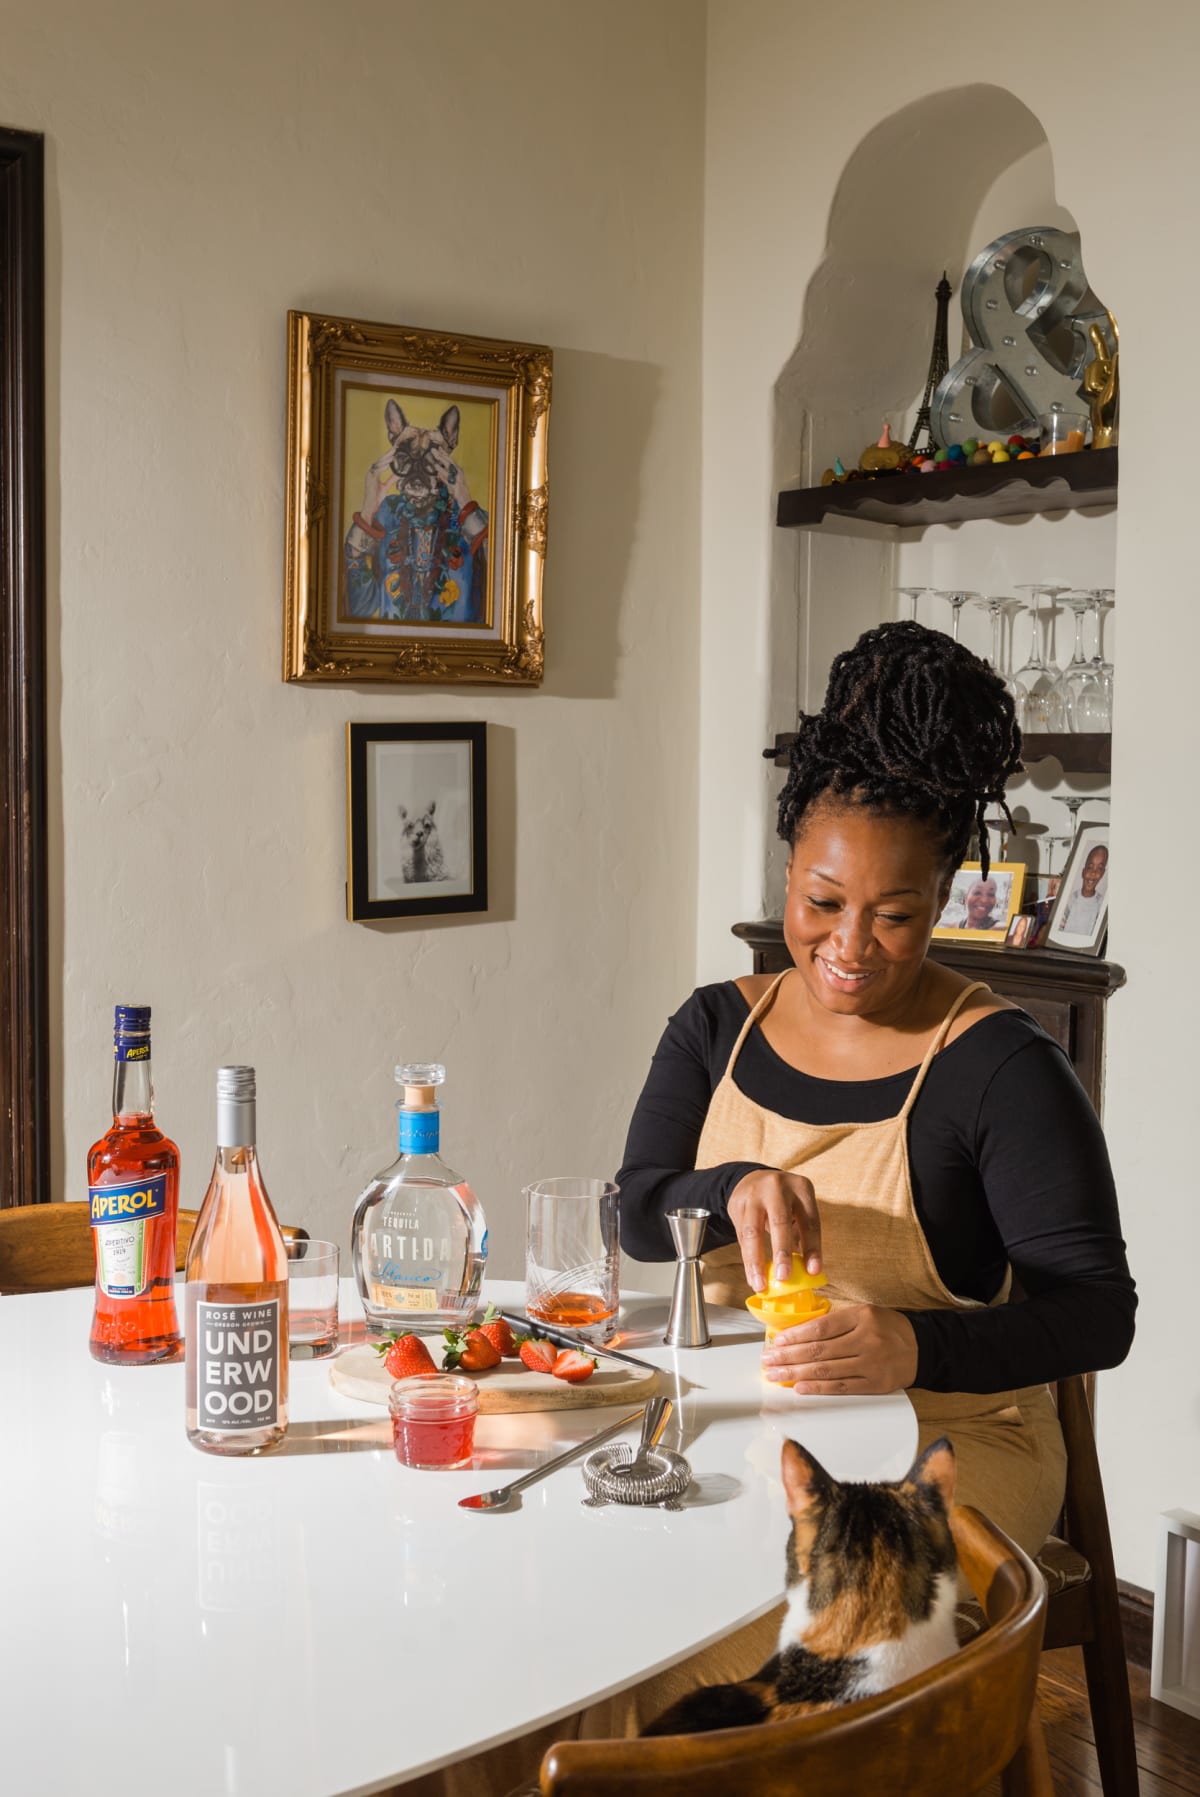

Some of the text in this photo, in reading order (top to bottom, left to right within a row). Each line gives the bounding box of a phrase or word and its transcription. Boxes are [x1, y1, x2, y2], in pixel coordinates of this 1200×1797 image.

[91, 1189, 157, 1219] APEROL
[384, 1216, 419, 1229] TEQUILA
[205, 1308, 272, 1320] ROSÉ WINE
[205, 1329, 272, 1355] UND
[206, 1358, 272, 1385] ERW
[205, 1389, 273, 1415] OOD
